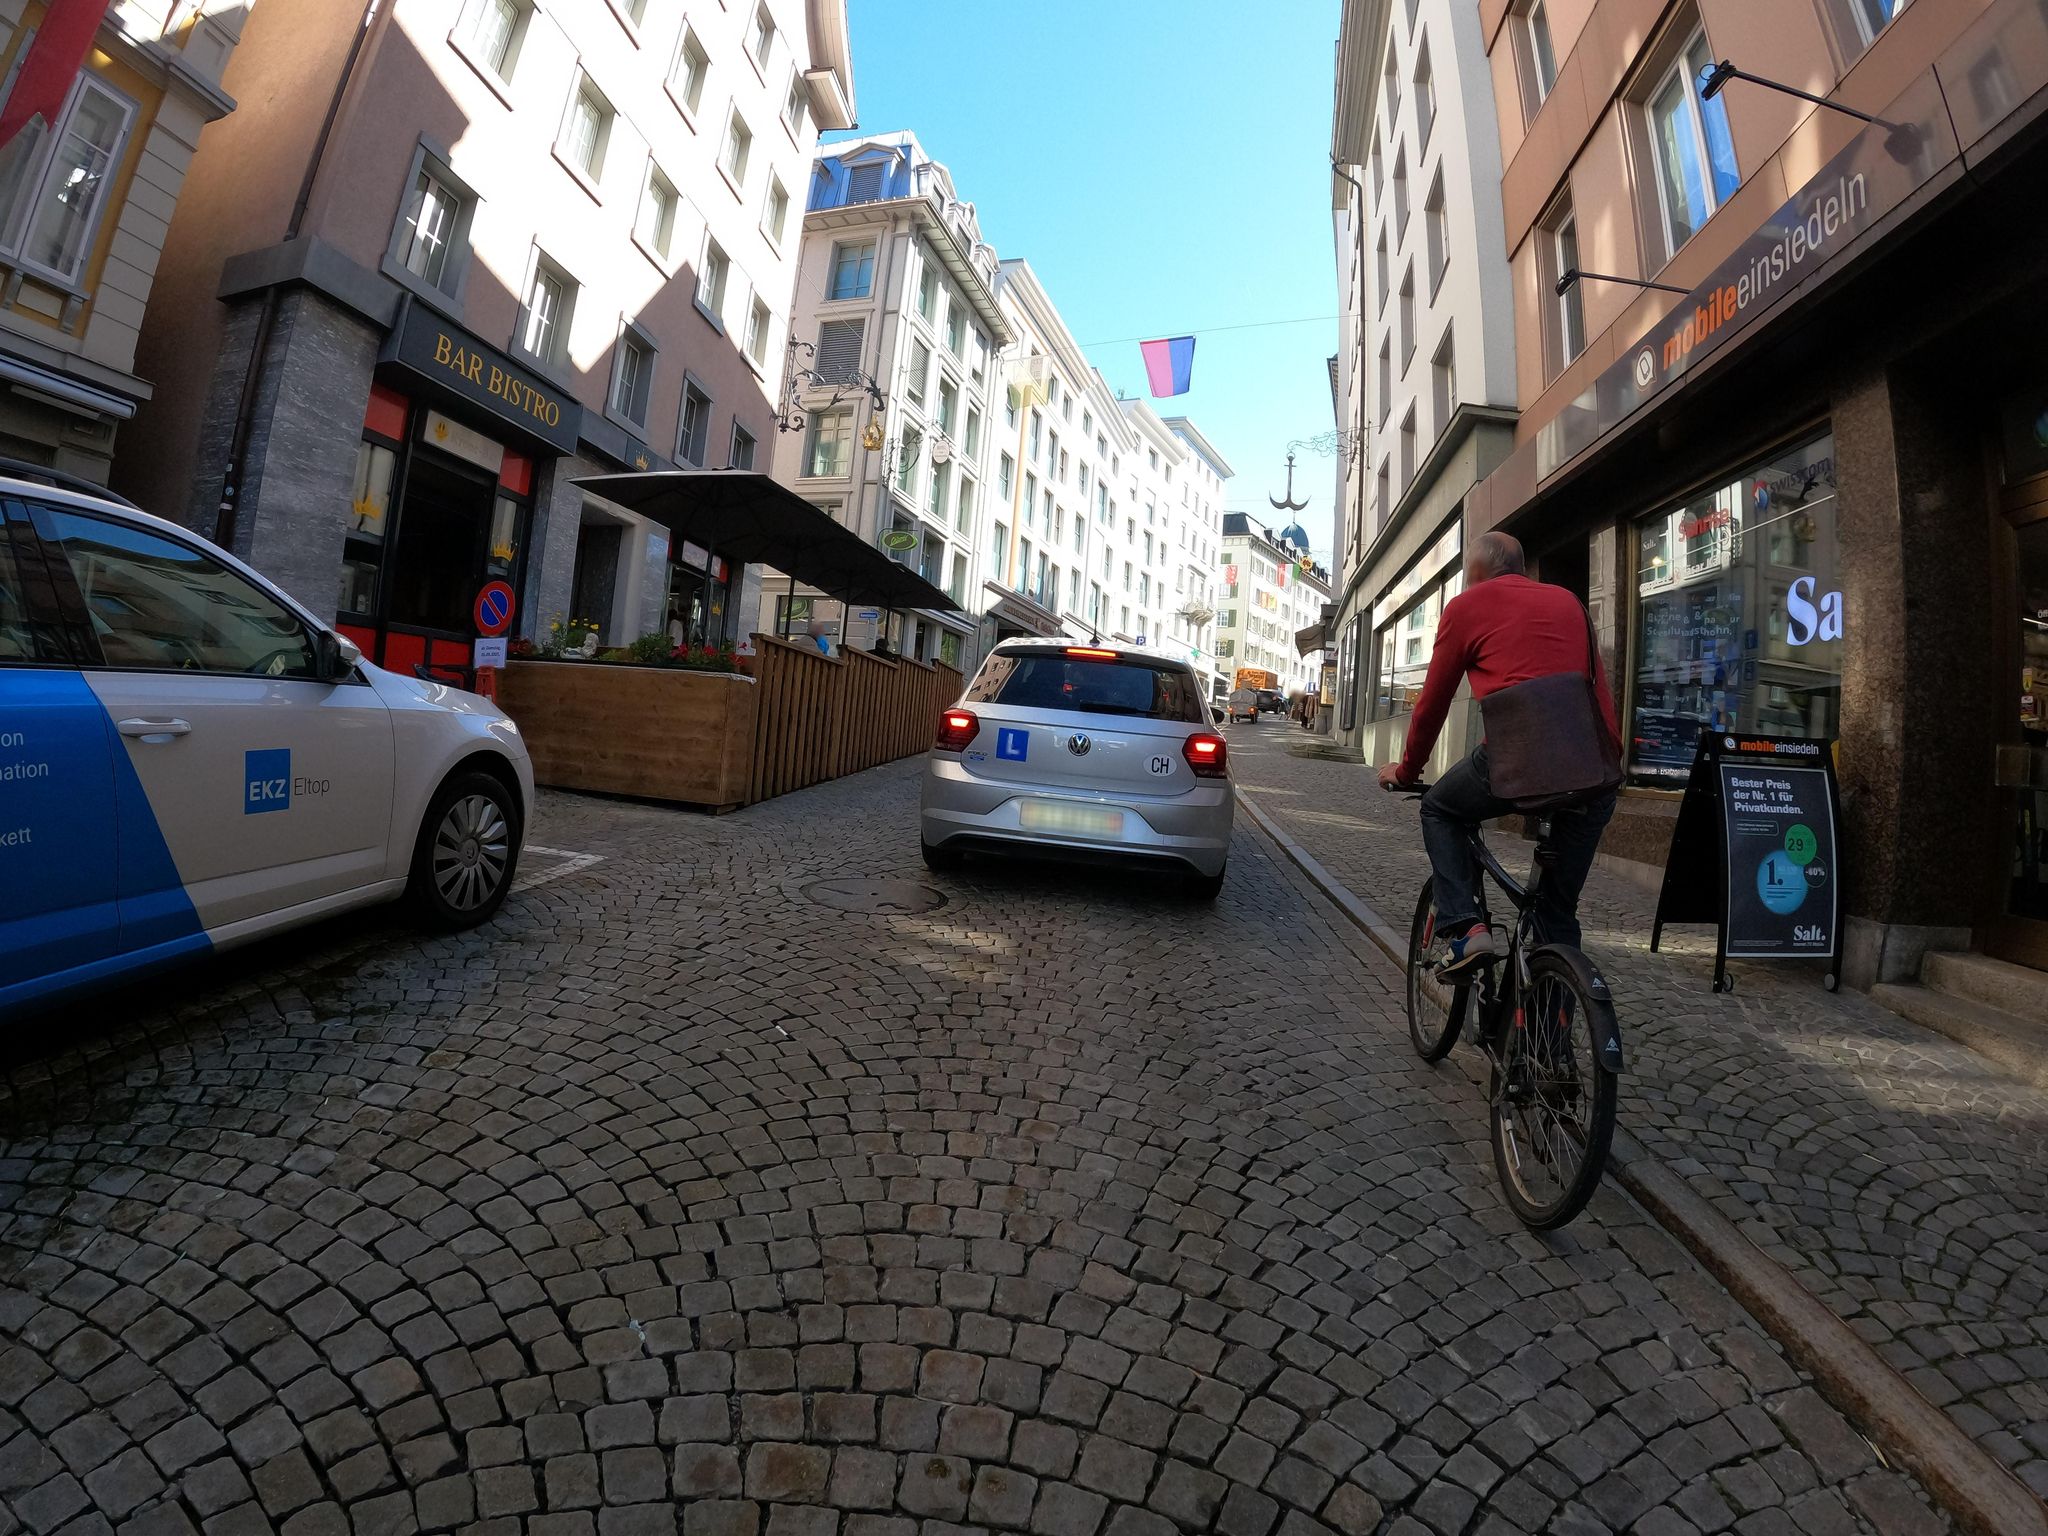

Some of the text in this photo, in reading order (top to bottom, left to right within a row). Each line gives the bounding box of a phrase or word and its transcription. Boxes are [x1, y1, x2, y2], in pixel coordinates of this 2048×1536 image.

[433, 333, 560, 426] BAR BISTRO
[1786, 576, 1842, 646] Sa
[1137, 637, 1145, 645] P
[1005, 732, 1020, 755] L
[1151, 757, 1169, 774] CH
[249, 778, 286, 802] EKZ
[294, 777, 330, 797] Eltop
[1731, 777, 1791, 790] Bester Preis
[1733, 790, 1794, 802] der Nr. 1 für
[1734, 802, 1803, 815] Privatkunden.
[1793, 924, 1826, 941] Salt.
